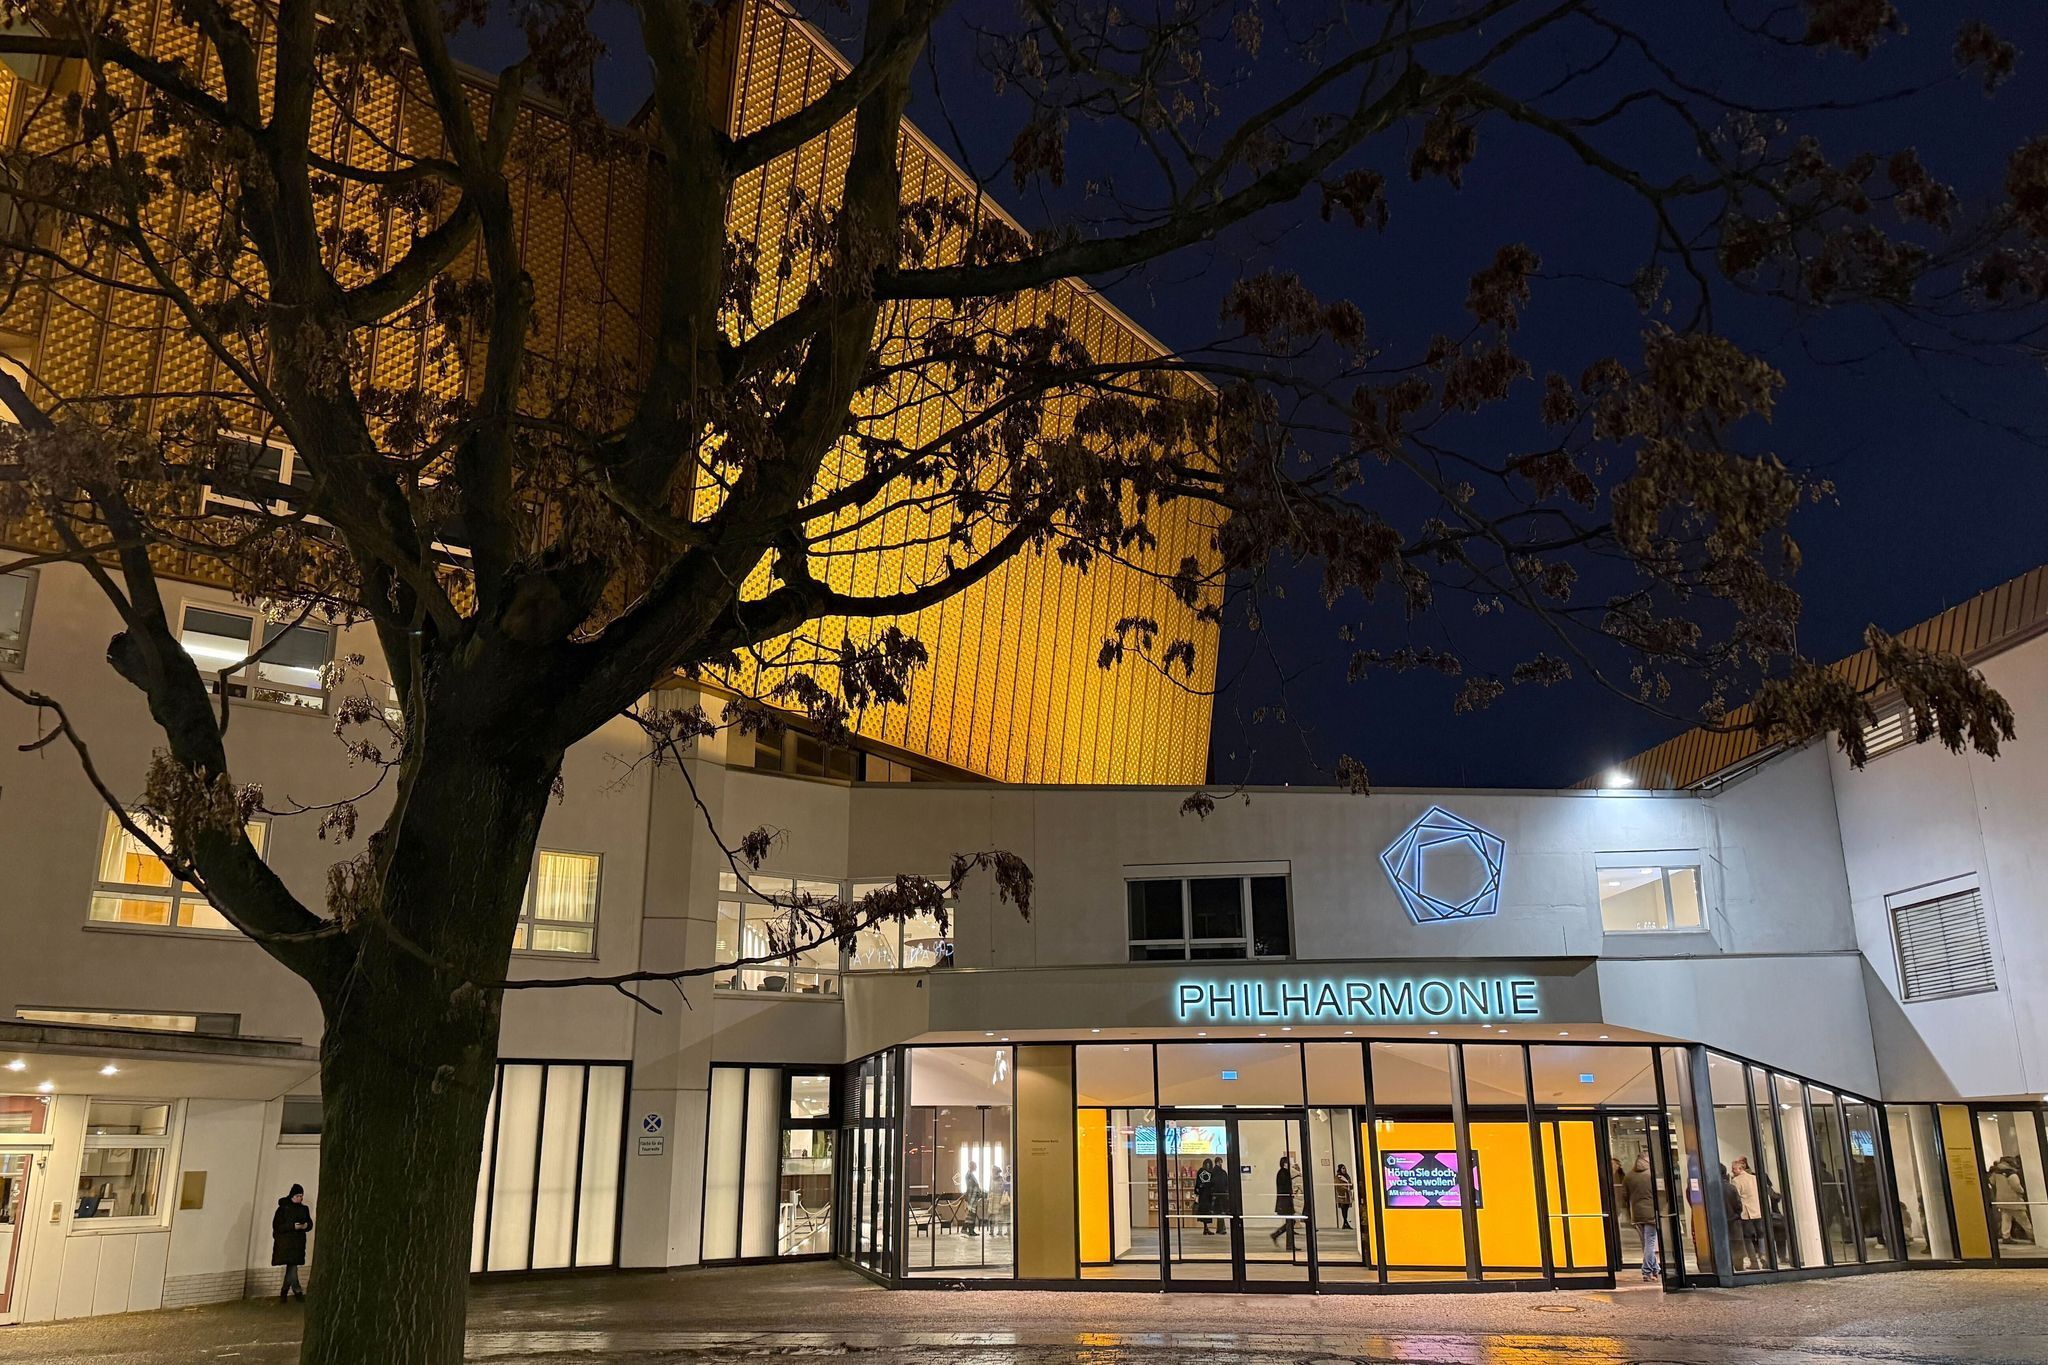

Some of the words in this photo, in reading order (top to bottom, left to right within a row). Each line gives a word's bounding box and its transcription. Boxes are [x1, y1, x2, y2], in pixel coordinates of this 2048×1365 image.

[1178, 979, 1540, 1018] PHILHARMONIE
[1388, 1167, 1415, 1177] Hören
[1416, 1167, 1430, 1177] Sie
[1431, 1167, 1456, 1178] doch,
[1389, 1178, 1407, 1186] was
[1408, 1177, 1423, 1186] Sie
[1423, 1177, 1456, 1186] wollen!
